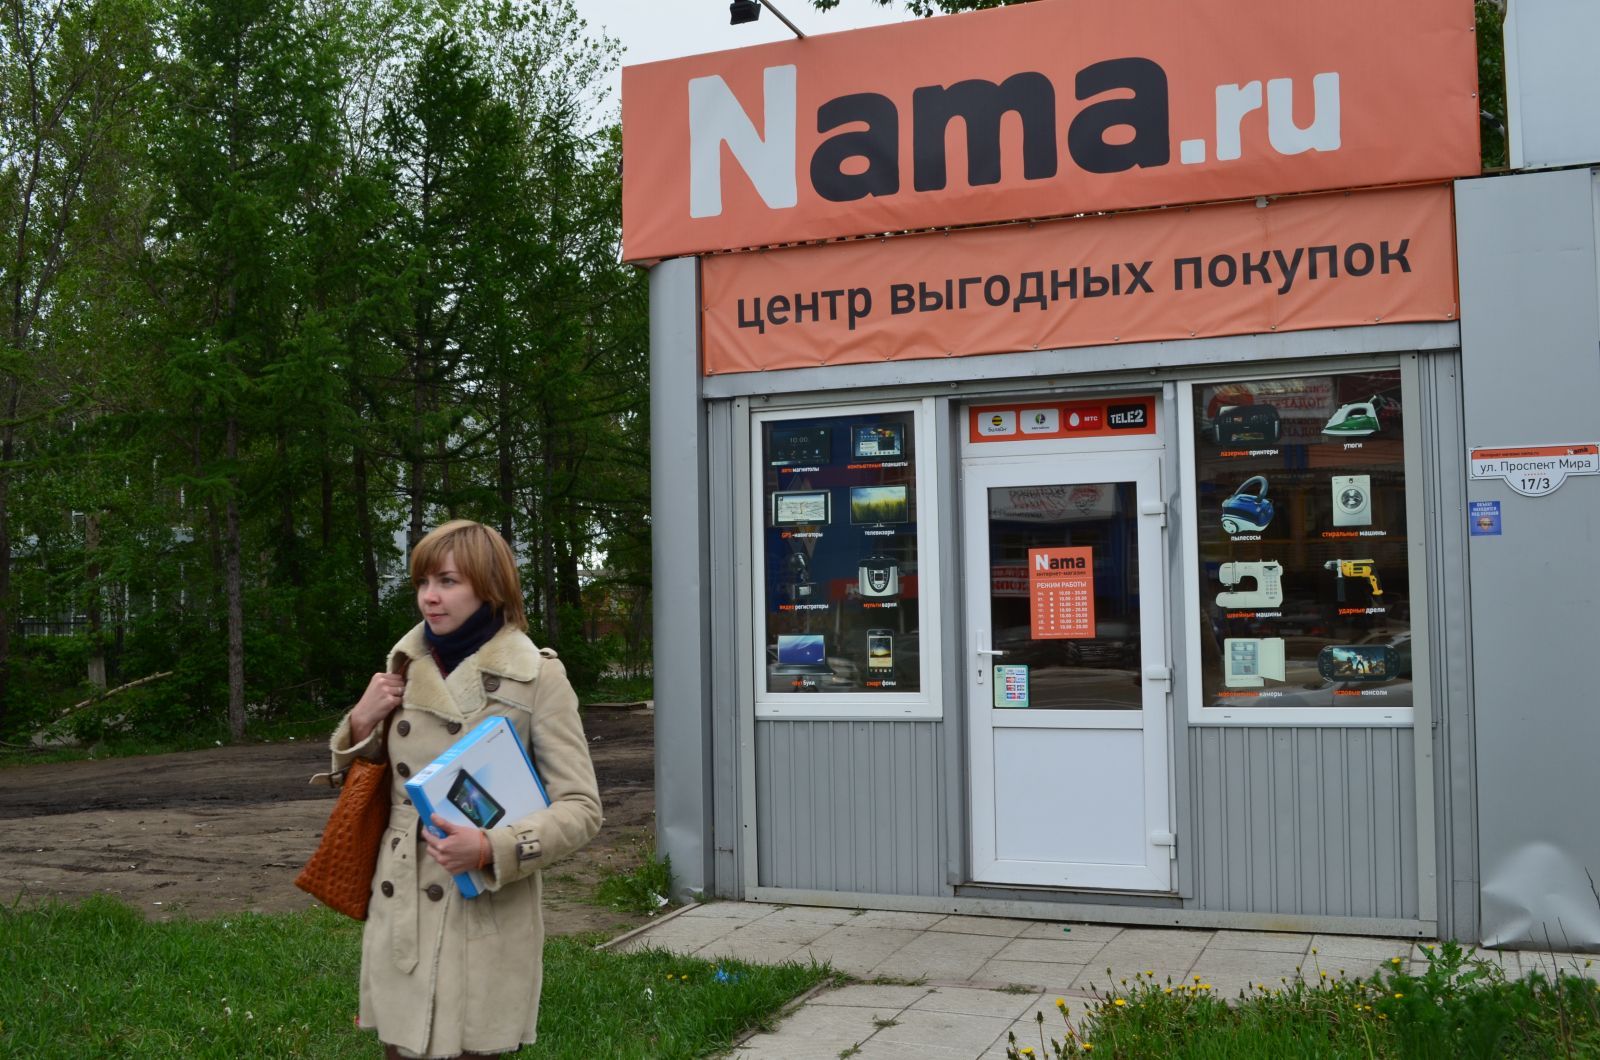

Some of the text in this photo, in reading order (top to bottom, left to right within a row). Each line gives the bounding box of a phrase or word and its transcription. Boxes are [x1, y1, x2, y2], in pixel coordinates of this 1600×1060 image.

[688, 56, 1340, 219] Nama.ru
[737, 238, 1412, 335] центр выгодных покупок
[1110, 410, 1144, 424] TELE2
[1249, 448, 1279, 457] принтеры
[1343, 442, 1363, 450] утюги
[1480, 459, 1591, 474] ул. Проспект Мира
[1521, 478, 1550, 490] 17/3
[1036, 554, 1085, 570] Nama
[1366, 607, 1386, 615] дрели
